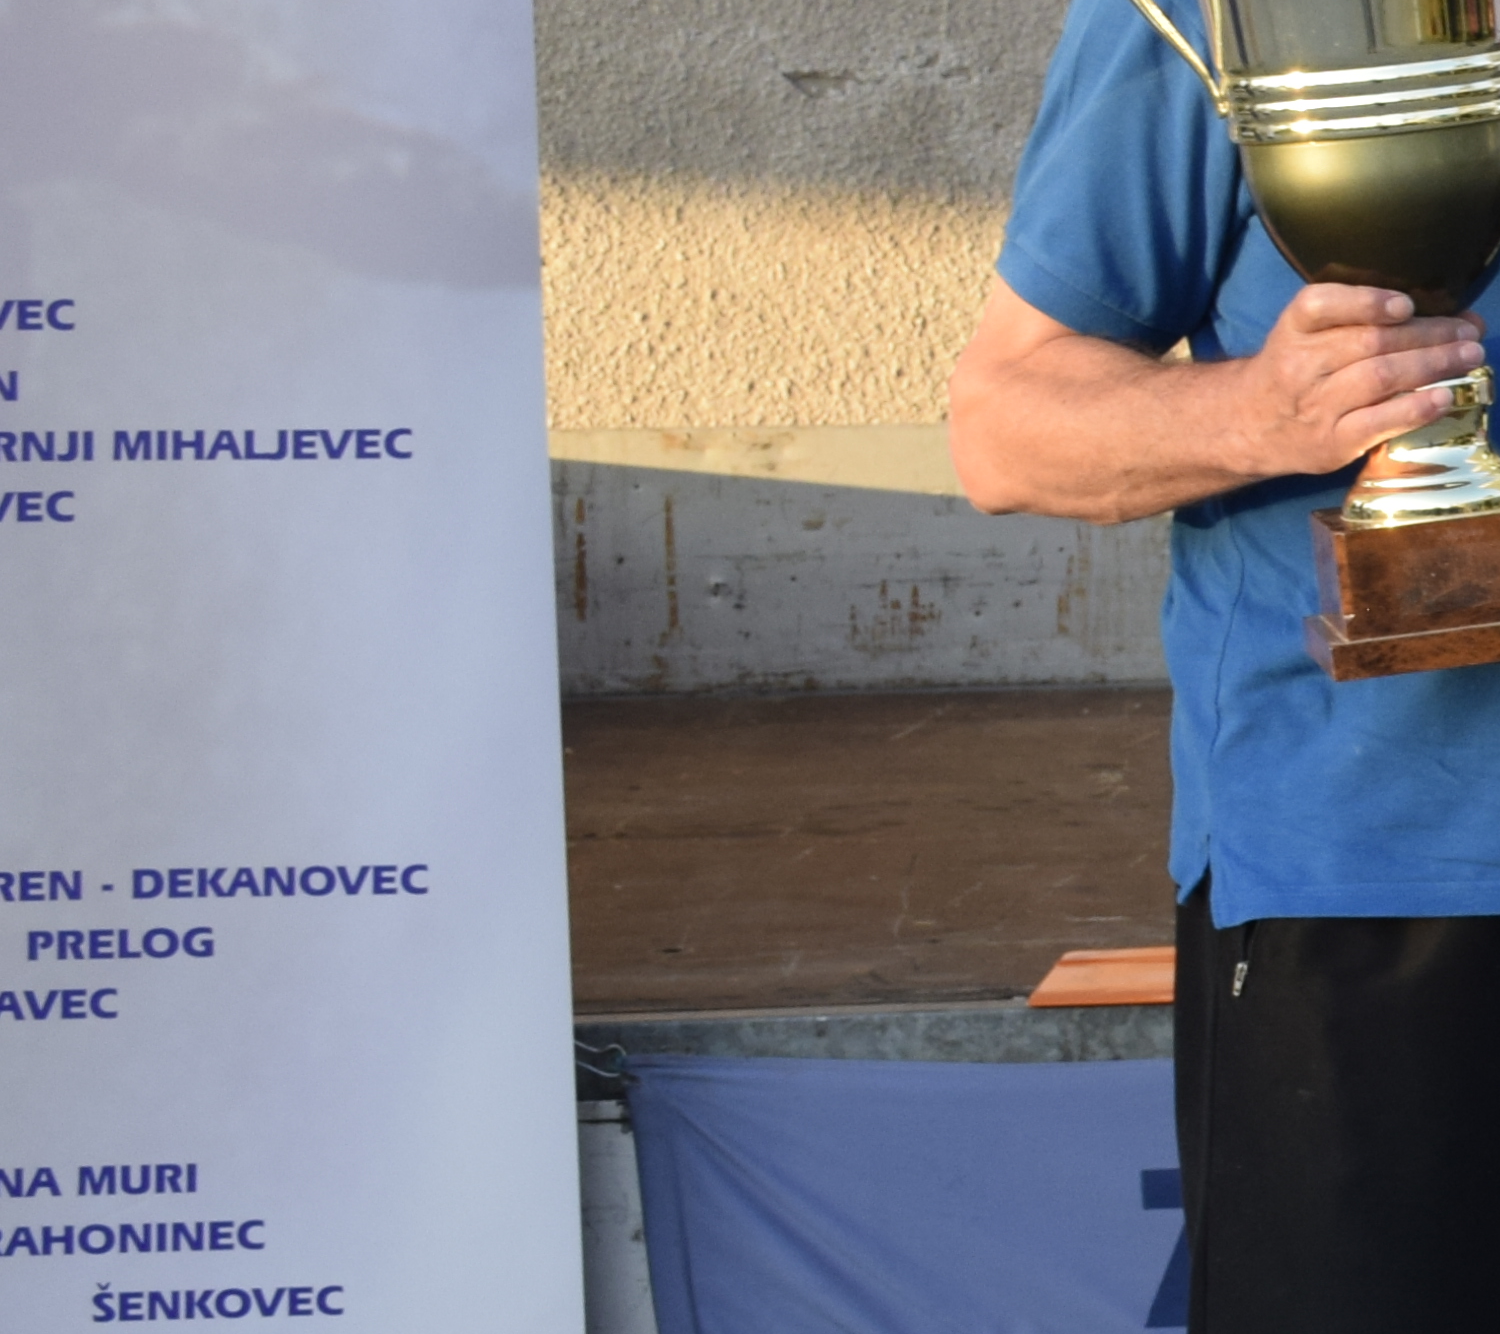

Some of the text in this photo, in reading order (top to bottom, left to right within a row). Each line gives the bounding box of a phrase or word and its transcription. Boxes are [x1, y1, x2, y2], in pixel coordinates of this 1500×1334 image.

[112, 428, 414, 462] MIHALJEVEC
[131, 864, 430, 900] DEKANOVEC
[27, 927, 215, 961] PRELOG
[77, 1163, 199, 1196] MURI
[92, 1282, 346, 1324] ŠENKOVEC
